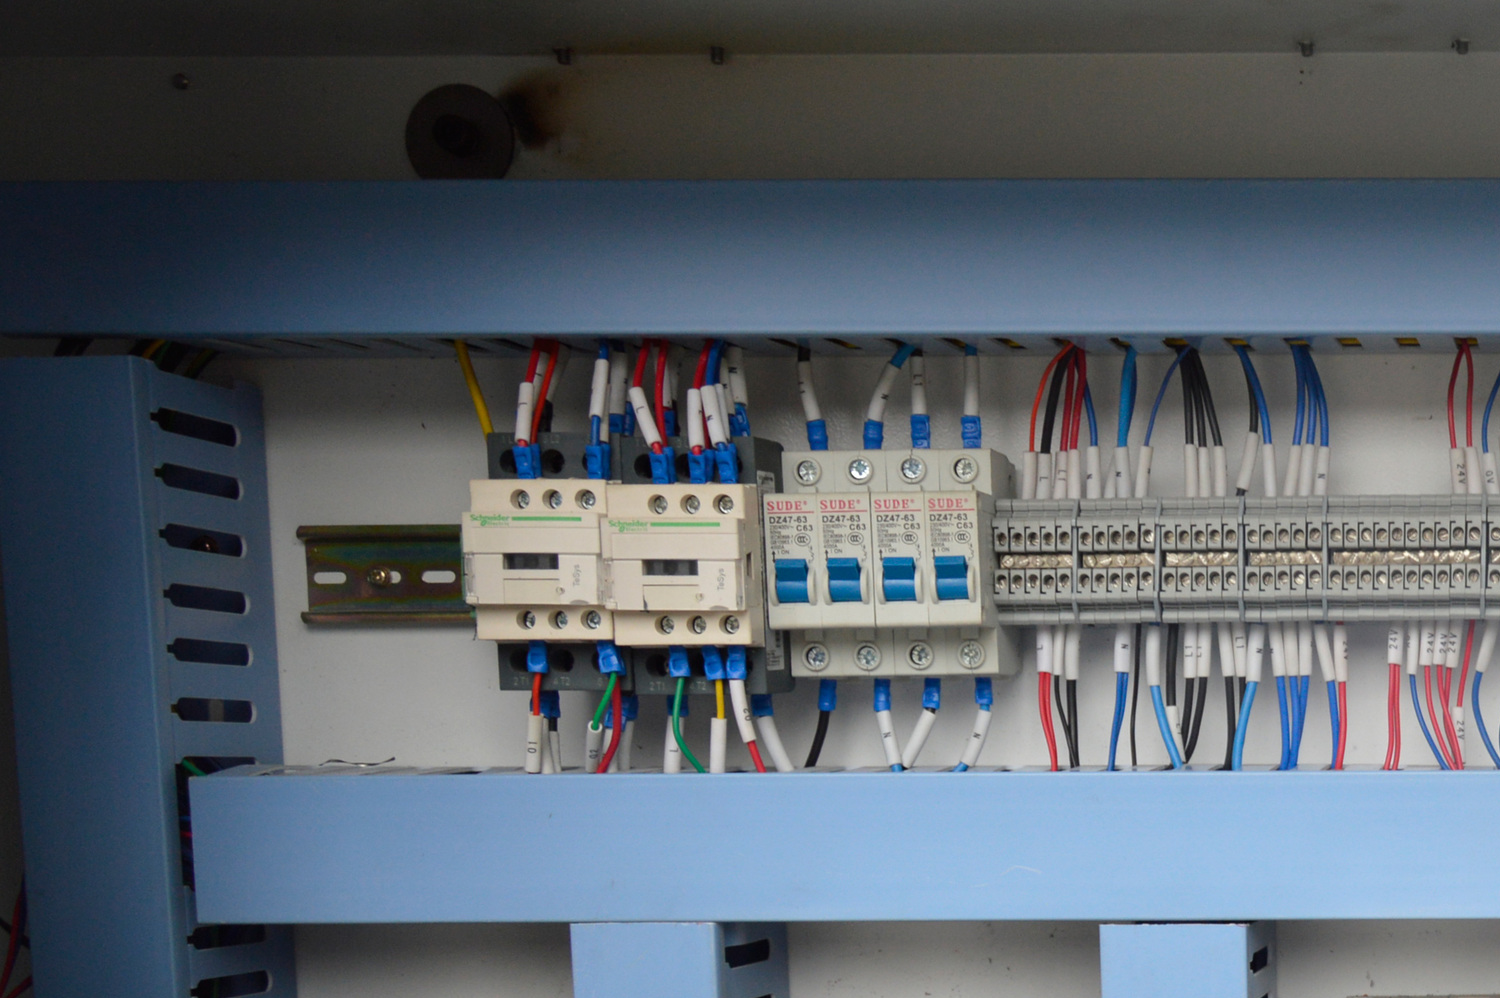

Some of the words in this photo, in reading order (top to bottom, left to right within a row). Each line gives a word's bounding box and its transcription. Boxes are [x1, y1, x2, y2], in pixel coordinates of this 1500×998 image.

[1456, 463, 1465, 484] 24V
[1485, 471, 1495, 484] 0V
[470, 514, 510, 523] Schneider
[609, 520, 649, 528] Schneider
[769, 515, 808, 524] DZ47-63
[822, 515, 861, 523] DZ47-63
[876, 514, 915, 522] DZ47-63
[930, 514, 968, 522] DZ47-63
[849, 523, 867, 531] C63
[572, 563, 580, 588] TeSys
[717, 568, 725, 591] TeSys
[1235, 636, 1245, 650] L1
[1389, 629, 1399, 650] 24V
[1449, 632, 1457, 653] 24V
[1456, 720, 1465, 740] 24V
